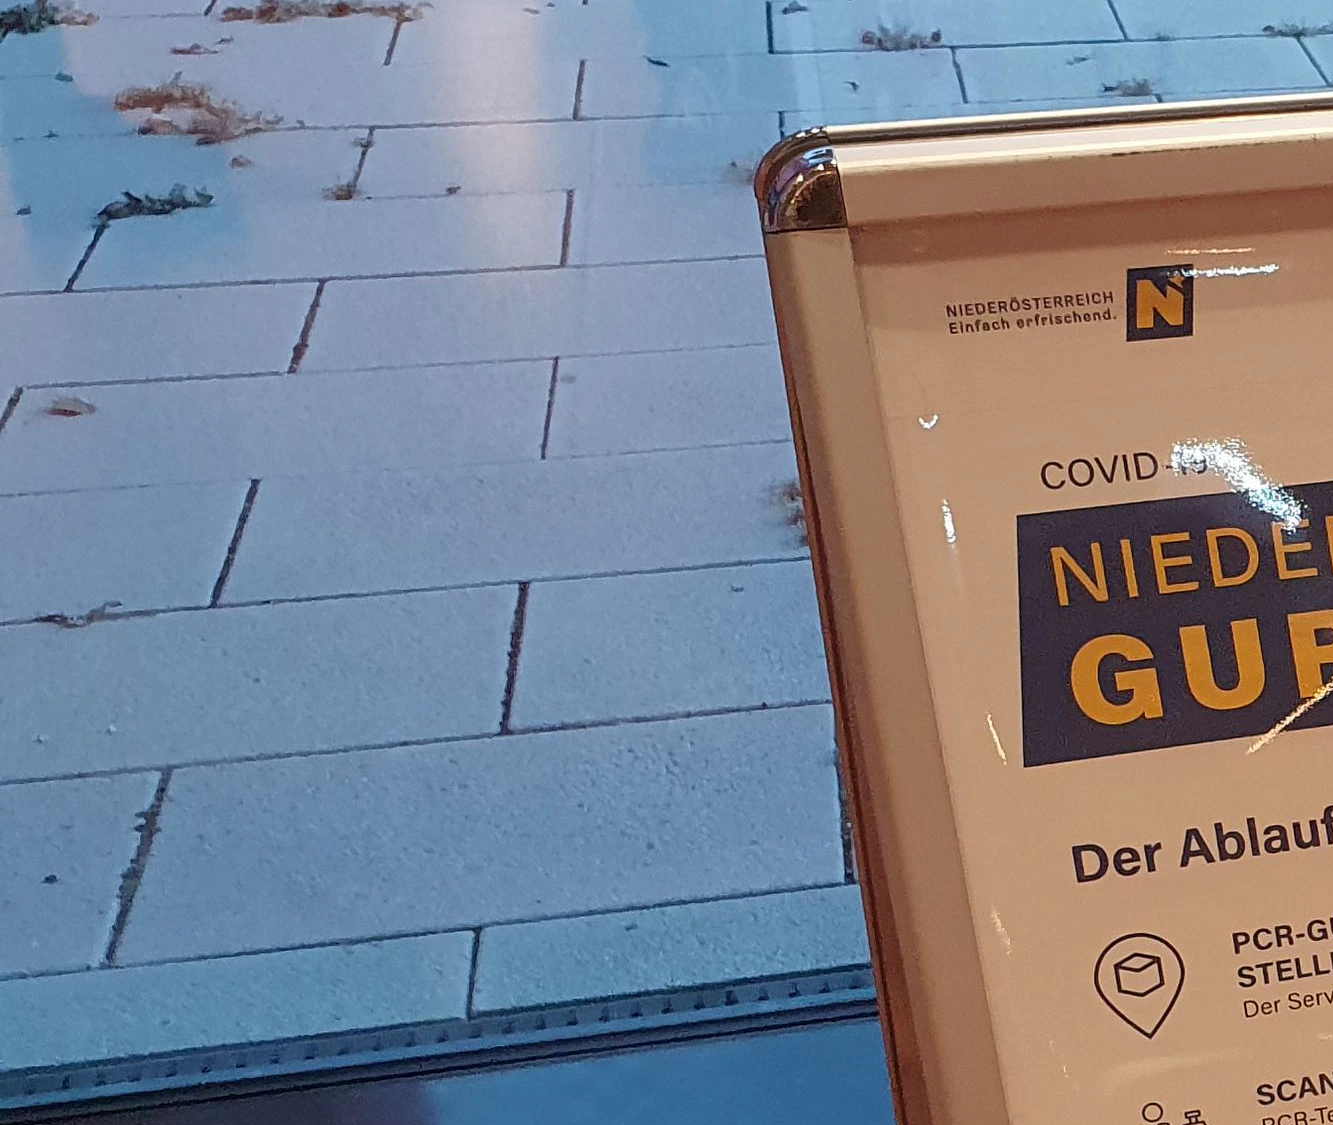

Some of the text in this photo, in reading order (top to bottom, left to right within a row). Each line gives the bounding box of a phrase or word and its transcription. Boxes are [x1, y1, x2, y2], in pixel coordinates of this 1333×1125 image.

[946, 291, 1114, 318] NIEDERÖSTERREICH
[949, 308, 1117, 335] Einfach erfrischend.
[1071, 842, 1162, 883] Der
